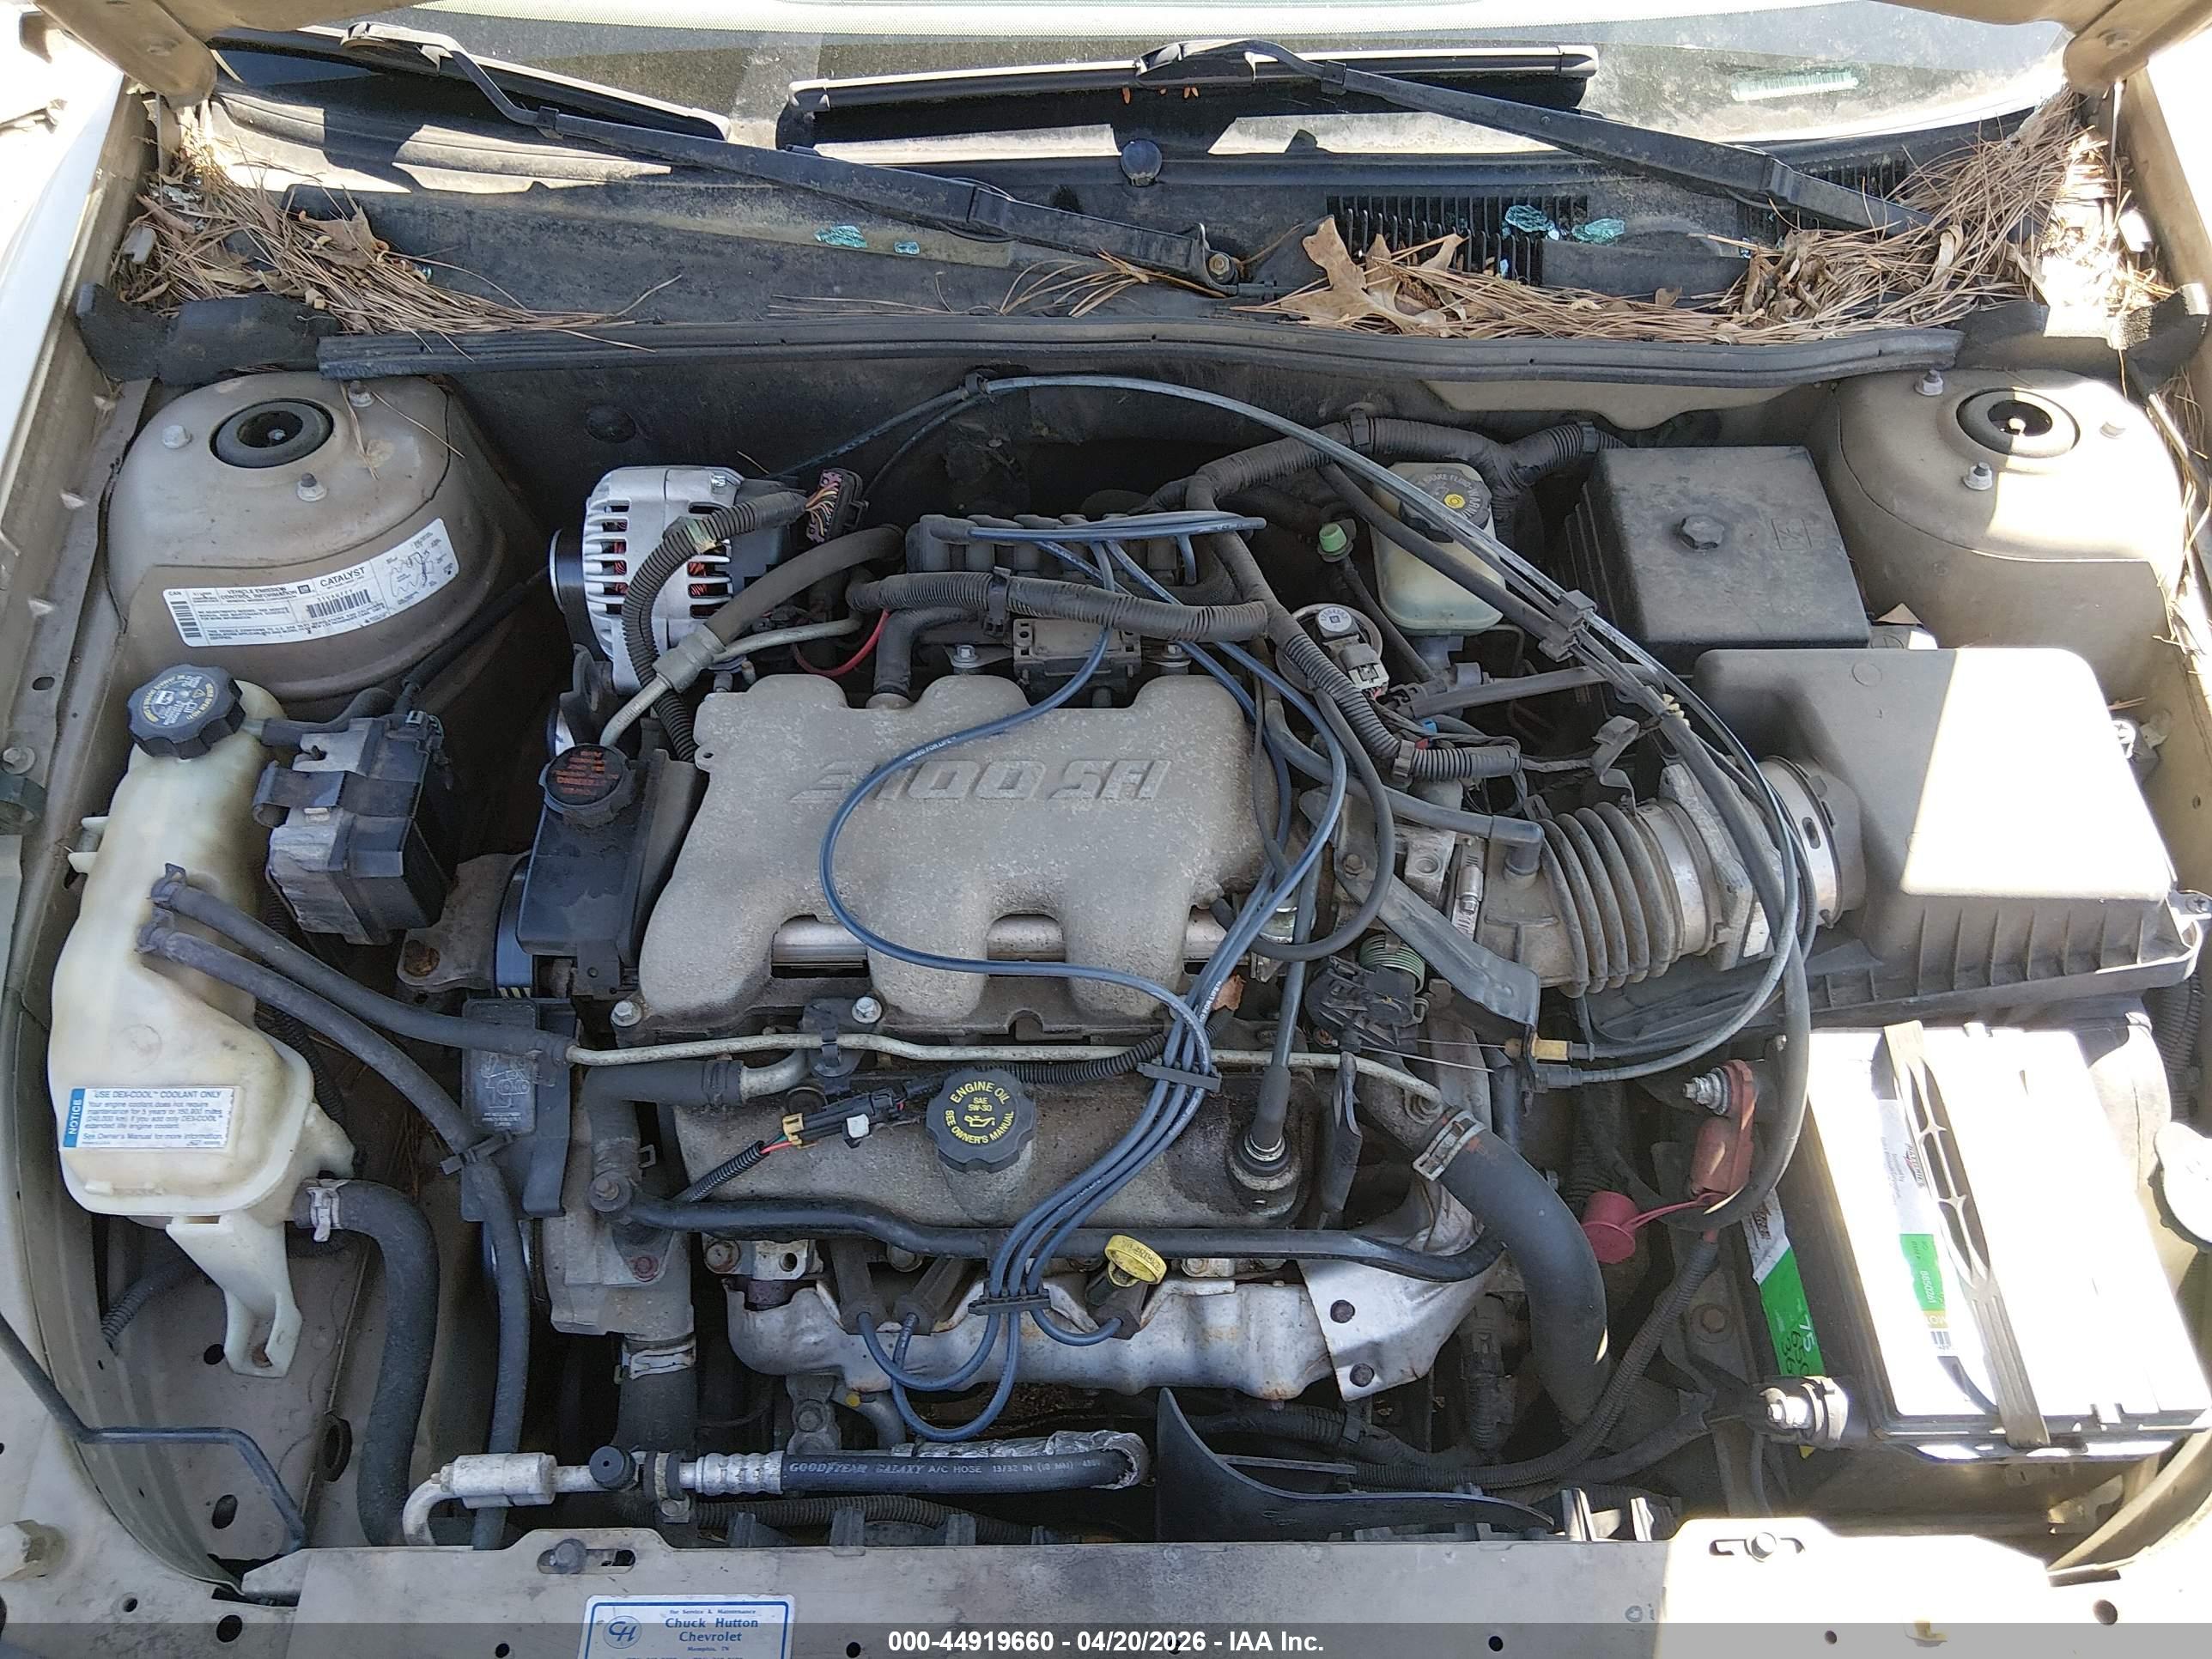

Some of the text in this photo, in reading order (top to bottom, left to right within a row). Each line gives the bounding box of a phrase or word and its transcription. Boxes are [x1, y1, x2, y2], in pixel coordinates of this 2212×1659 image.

[320, 567, 365, 586] CATALYST
[1048, 758, 1174, 802] SFI
[950, 1081, 1010, 1105] ENGINE OIL
[69, 1099, 82, 1135] NOTICE
[967, 1103, 993, 1112] 5W-30
[945, 1109, 1014, 1144] SEE OWNER'S MANUAL
[1799, 1314, 1815, 1352] 75
[789, 1462, 868, 1474] GOODYEAR
[874, 1462, 926, 1474] GALAXY
[927, 1463, 949, 1474] A/C
[952, 1465, 982, 1474] HOSE
[992, 1464, 1018, 1473] 13/32
[1023, 1463, 1033, 1472] IN
[609, 1621, 637, 1643] CH
[665, 1617, 759, 1628] Chuck Hutton
[679, 1631, 743, 1642] Chevrolet
